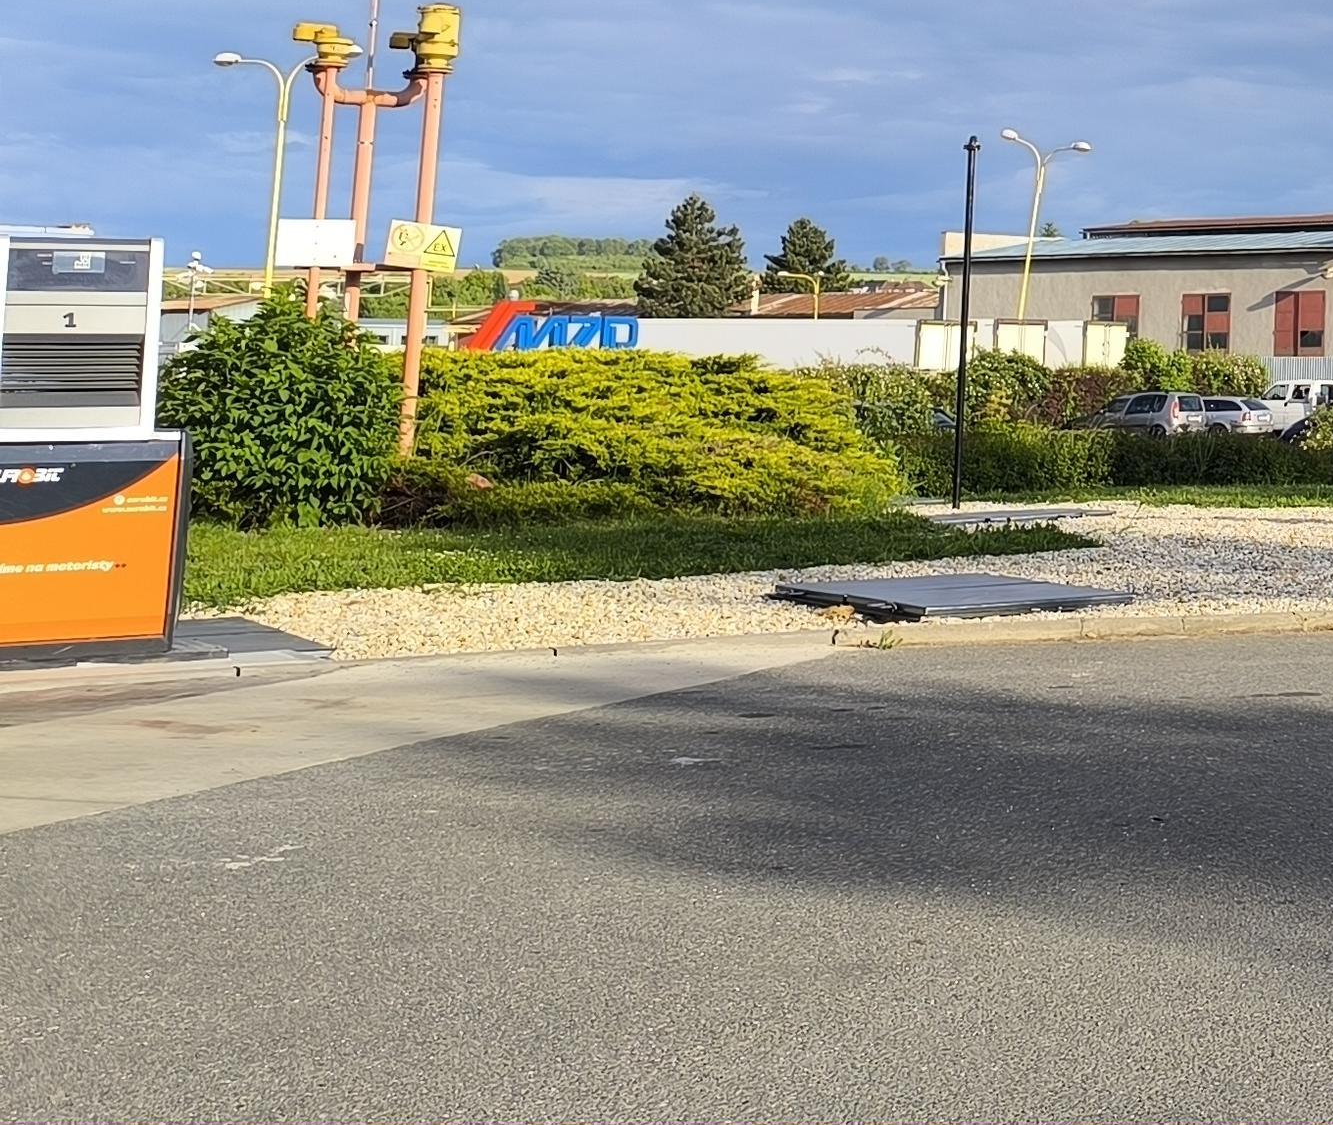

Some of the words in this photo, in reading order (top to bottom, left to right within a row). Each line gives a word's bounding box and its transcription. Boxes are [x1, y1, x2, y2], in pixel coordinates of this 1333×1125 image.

[433, 242, 448, 253] EX
[63, 312, 77, 328] 1
[25, 564, 44, 573] na
